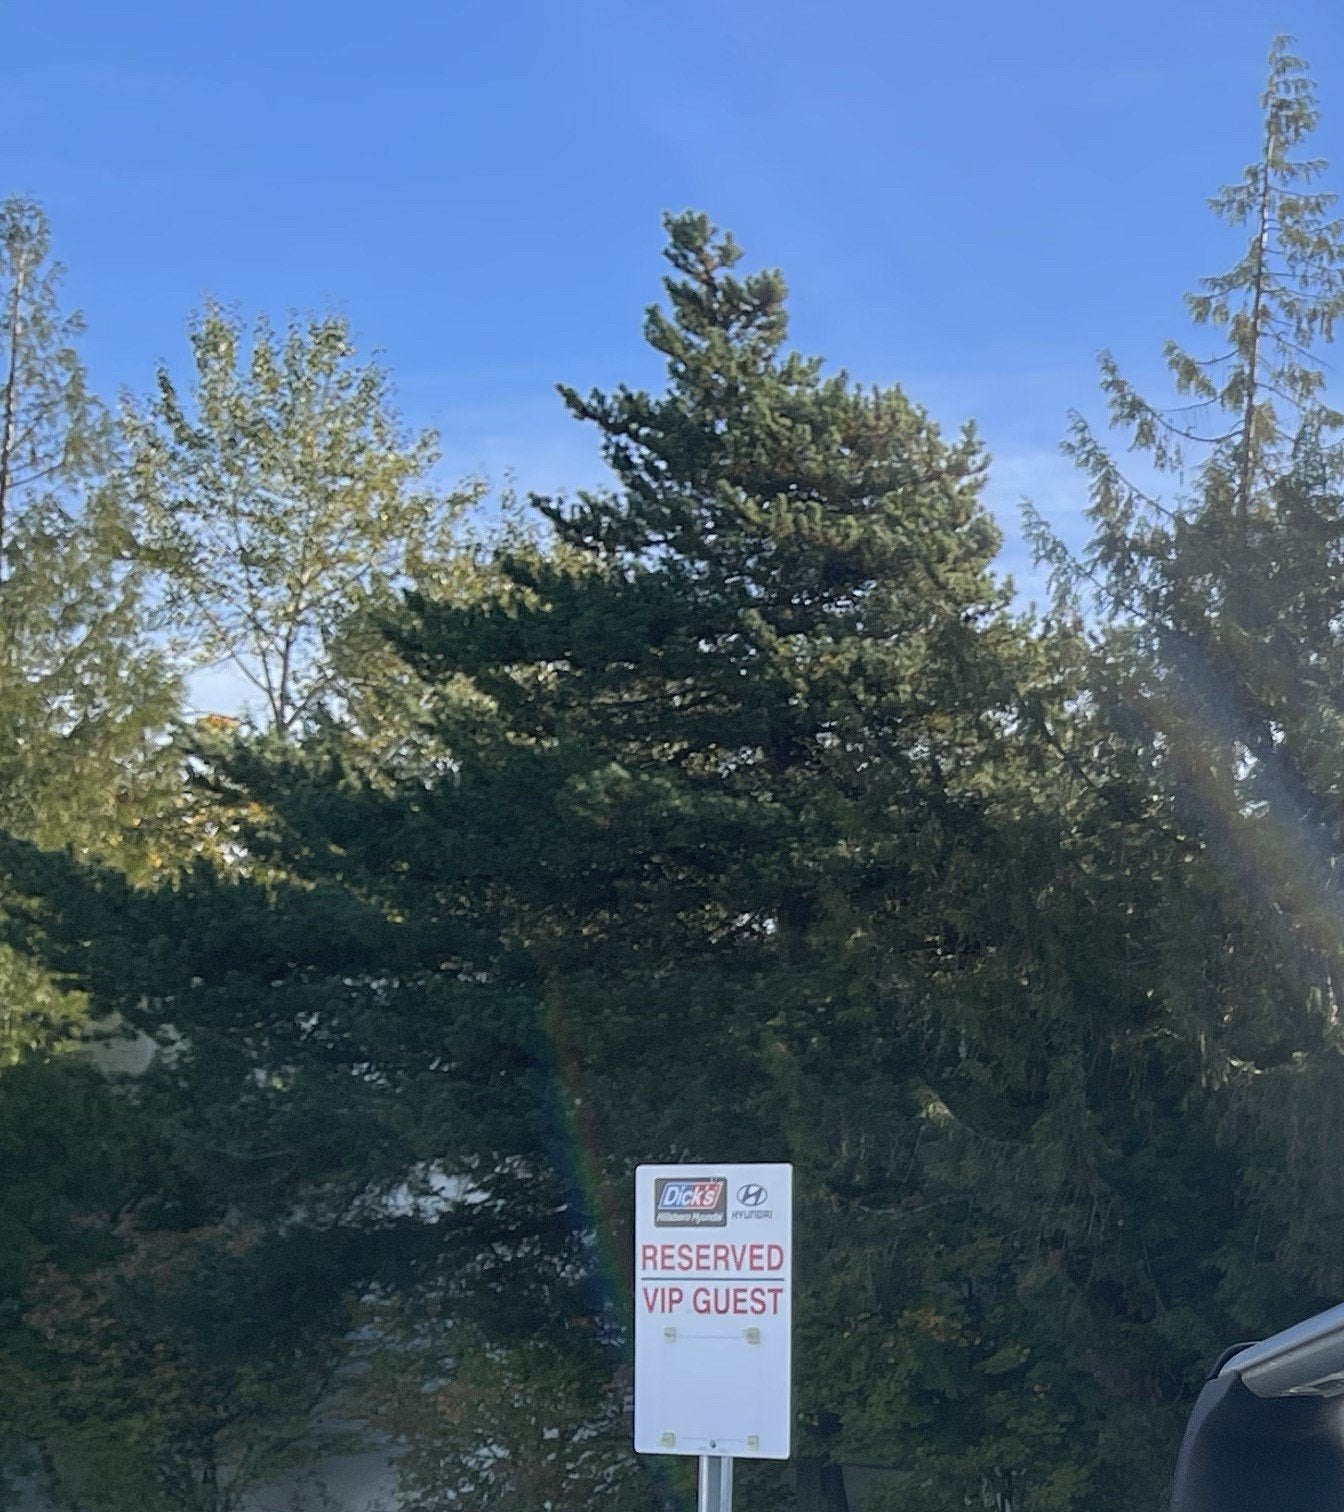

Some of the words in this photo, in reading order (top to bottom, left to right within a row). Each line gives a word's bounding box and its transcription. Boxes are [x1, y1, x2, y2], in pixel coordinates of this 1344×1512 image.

[664, 1185, 716, 1206] Dick's
[731, 1210, 773, 1219] HYUNDAI
[641, 1243, 785, 1272] RESERVED
[642, 1287, 684, 1314] VIP
[692, 1287, 784, 1316] GUEST
